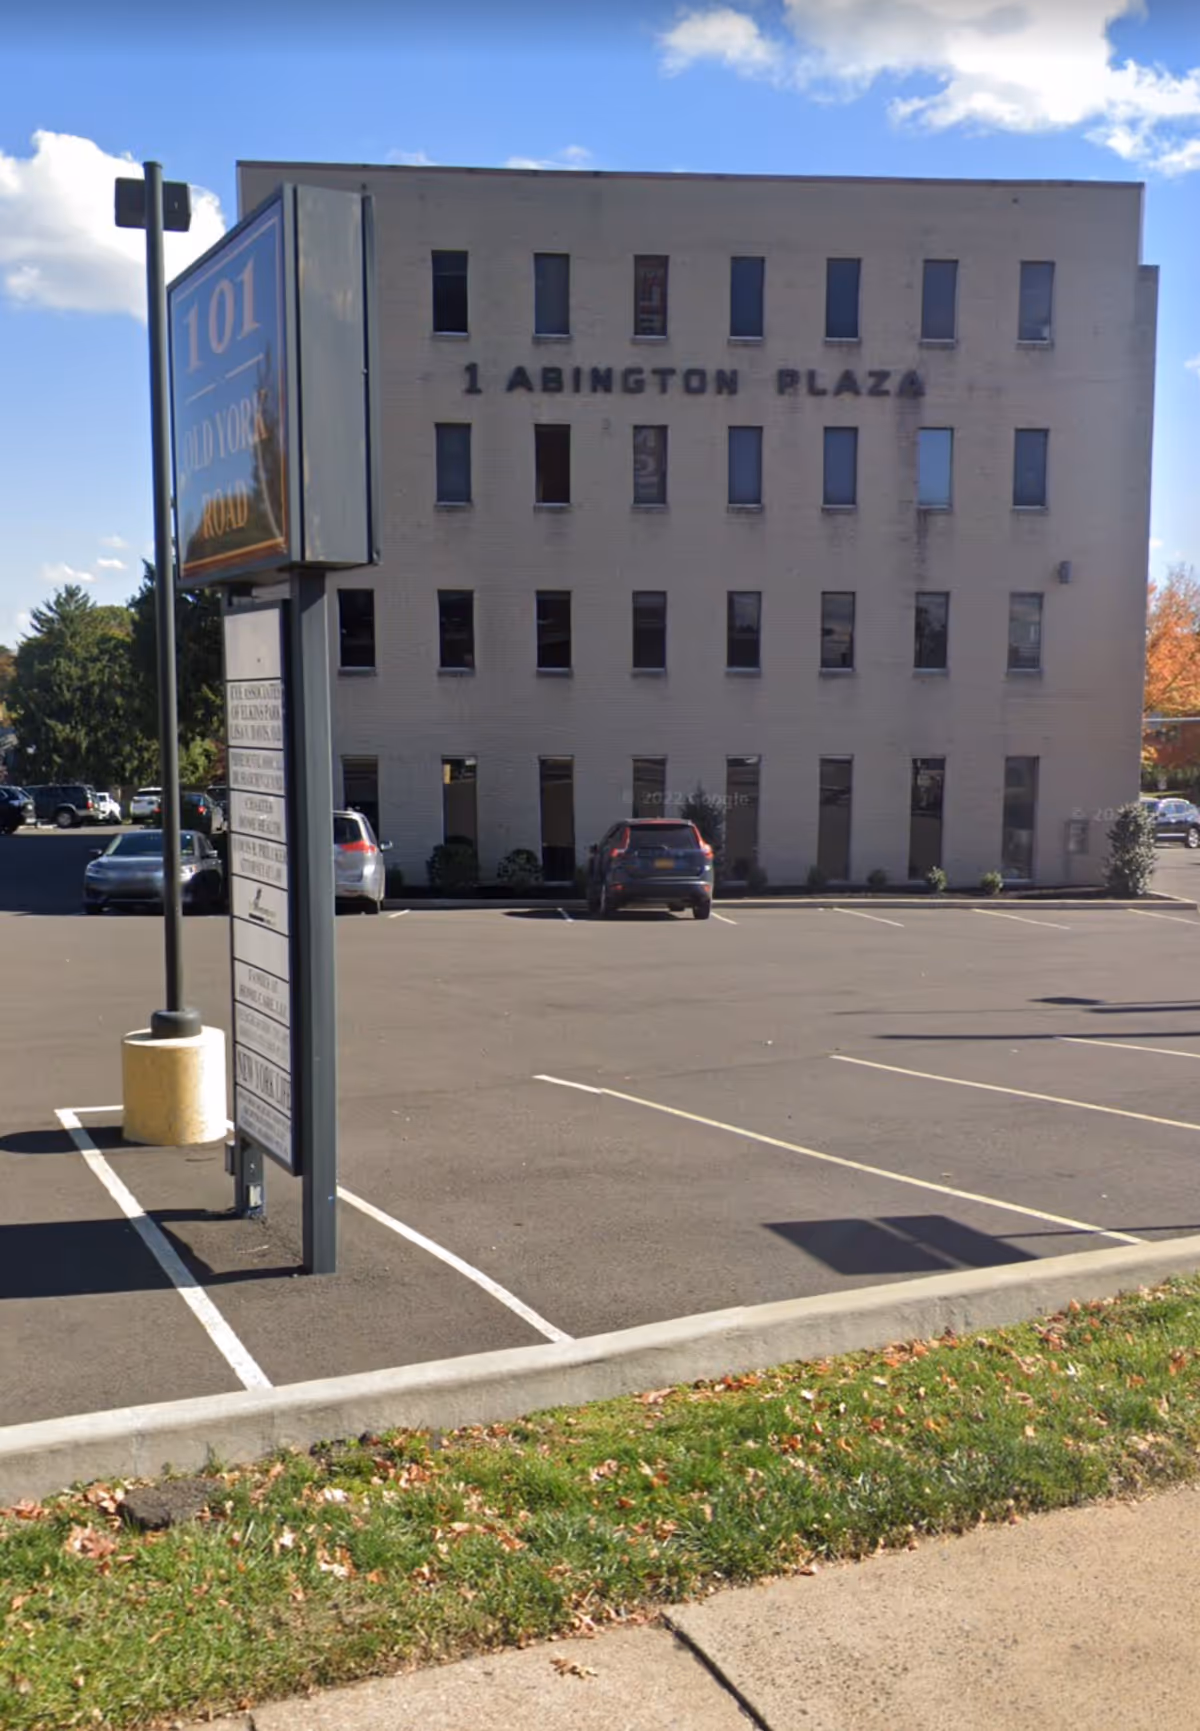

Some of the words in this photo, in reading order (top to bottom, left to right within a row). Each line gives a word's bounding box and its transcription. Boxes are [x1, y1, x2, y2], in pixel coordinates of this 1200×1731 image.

[182, 256, 261, 374] 101
[463, 362, 483, 394] 1
[506, 366, 738, 395] ABINGTON
[776, 368, 927, 398] PLAZA
[184, 419, 214, 472] OLD
[215, 389, 268, 460] YORK
[202, 479, 249, 540] ROAD
[237, 1050, 253, 1082] NEW
[254, 1060, 275, 1098] YORK
